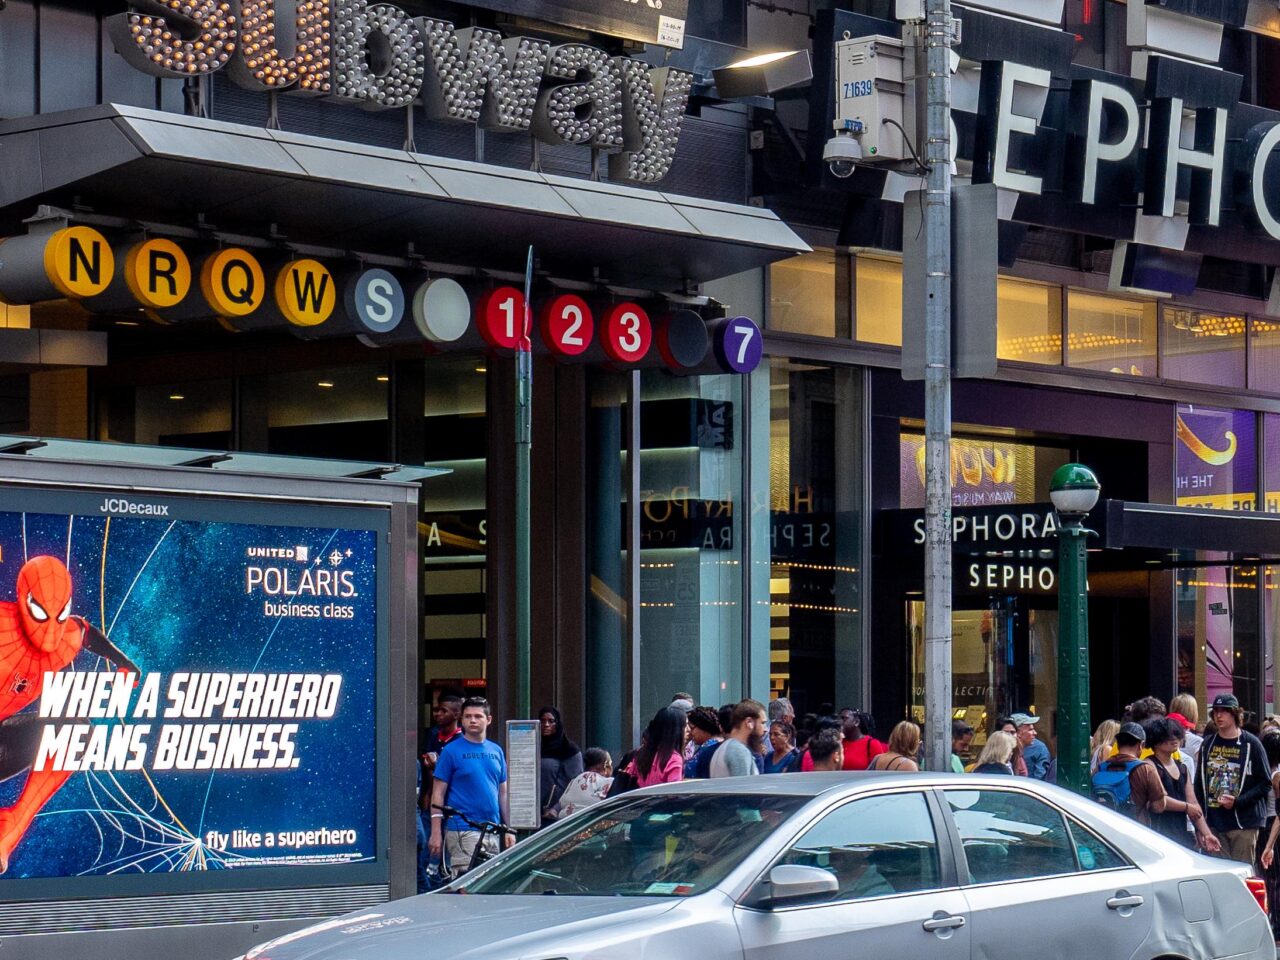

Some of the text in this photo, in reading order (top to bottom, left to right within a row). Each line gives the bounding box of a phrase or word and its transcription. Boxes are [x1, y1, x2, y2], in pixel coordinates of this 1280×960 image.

[69, 237, 754, 364] N R Q W S 1 2 3 7
[100, 498, 169, 516] JCDecaux
[913, 512, 1059, 544] SPHORA
[248, 548, 295, 559] UNITED
[264, 601, 354, 619] business class
[39, 671, 342, 718] WHEN A SUPERHERO
[33, 723, 300, 771] MEANS BUSINESS.
[206, 827, 357, 851] fly like a superhero
